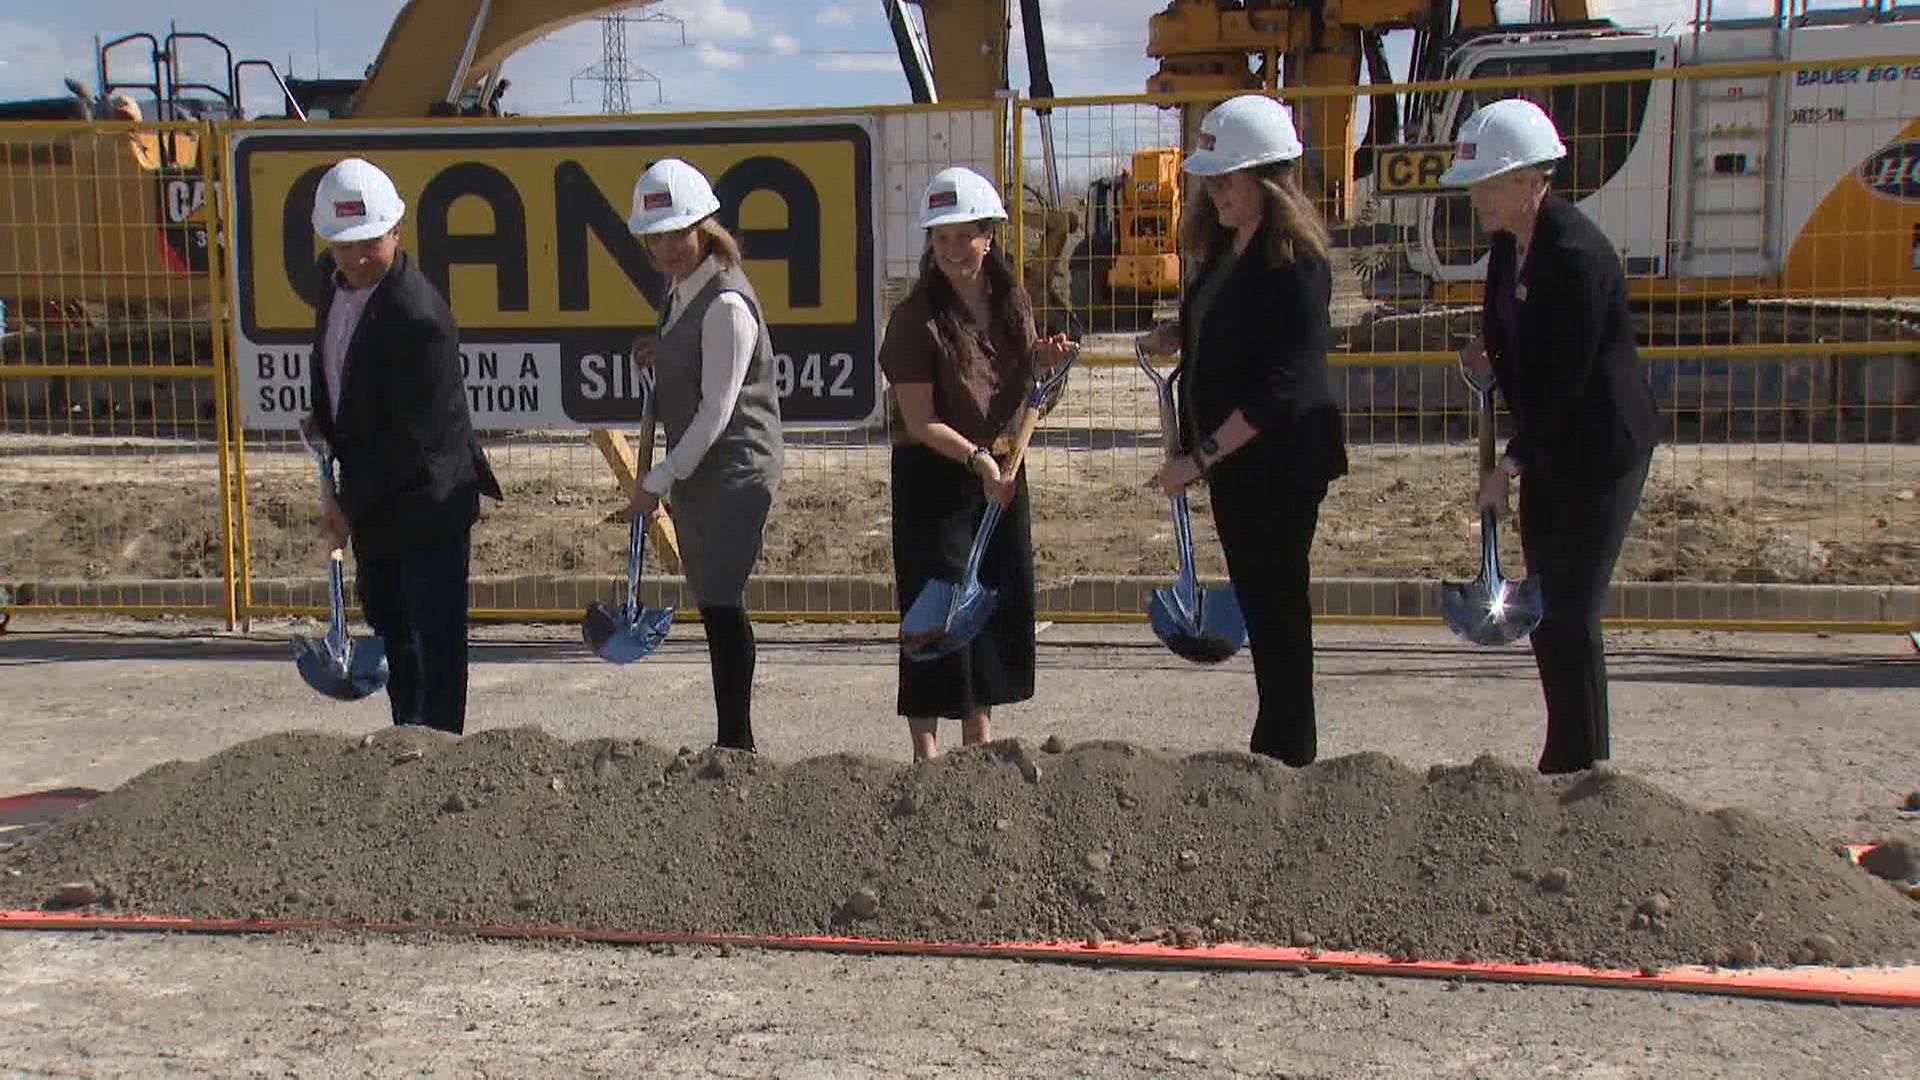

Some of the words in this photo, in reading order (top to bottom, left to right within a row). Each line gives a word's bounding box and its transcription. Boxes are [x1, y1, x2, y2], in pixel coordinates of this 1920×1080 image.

[1796, 68, 1857, 86] BAUER
[1866, 66, 1898, 82] BG
[1389, 154, 1443, 186] CA
[519, 352, 540, 379] A
[580, 354, 656, 399] SIN
[775, 353, 854, 397] 942
[259, 385, 313, 412] SOL
